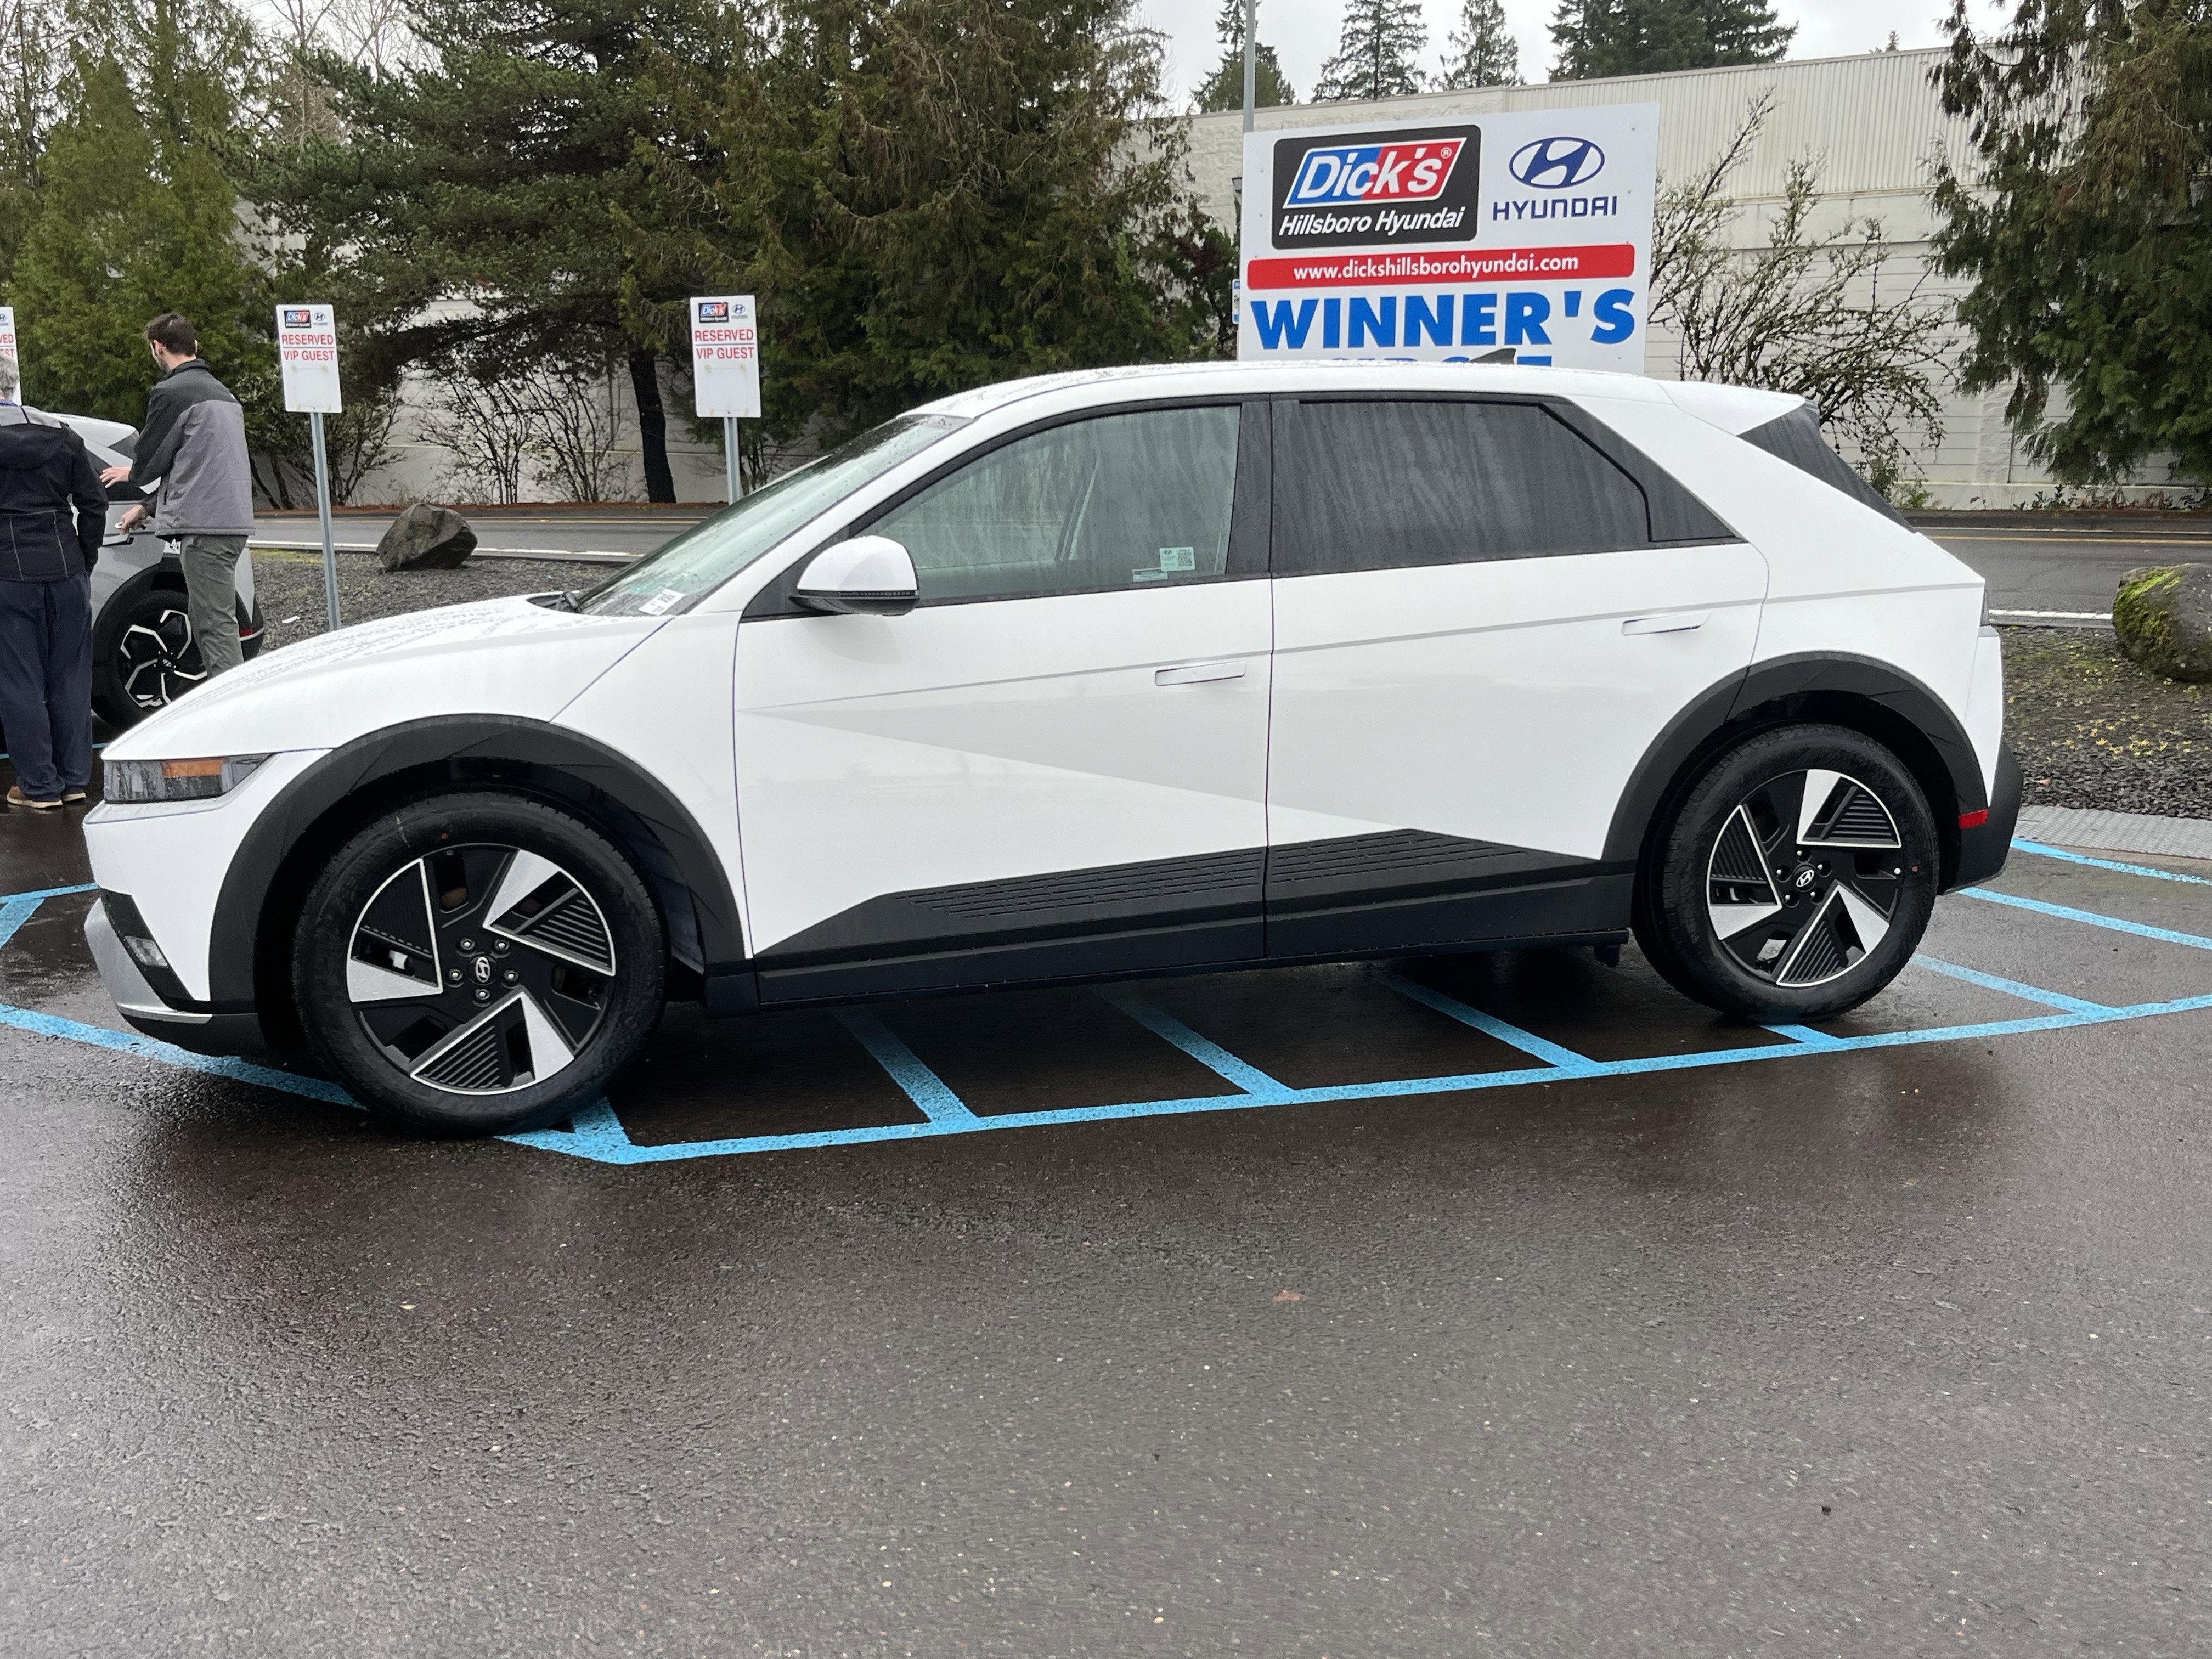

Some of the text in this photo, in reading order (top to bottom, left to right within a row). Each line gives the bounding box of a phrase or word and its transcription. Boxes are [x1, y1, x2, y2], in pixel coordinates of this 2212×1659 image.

[1297, 146, 1443, 199] Dick's
[1278, 206, 1466, 236] Hillsboro Hyundai
[1492, 196, 1617, 221] HYUNDAI
[1293, 252, 1579, 279] www.dickshillsborohyundai.com
[1250, 287, 1635, 350] WINNER'S
[281, 334, 334, 345] RESERVED
[695, 329, 754, 342] RESERVED
[283, 350, 334, 361] VIP GUEST
[696, 347, 754, 359] VIP GUEST
